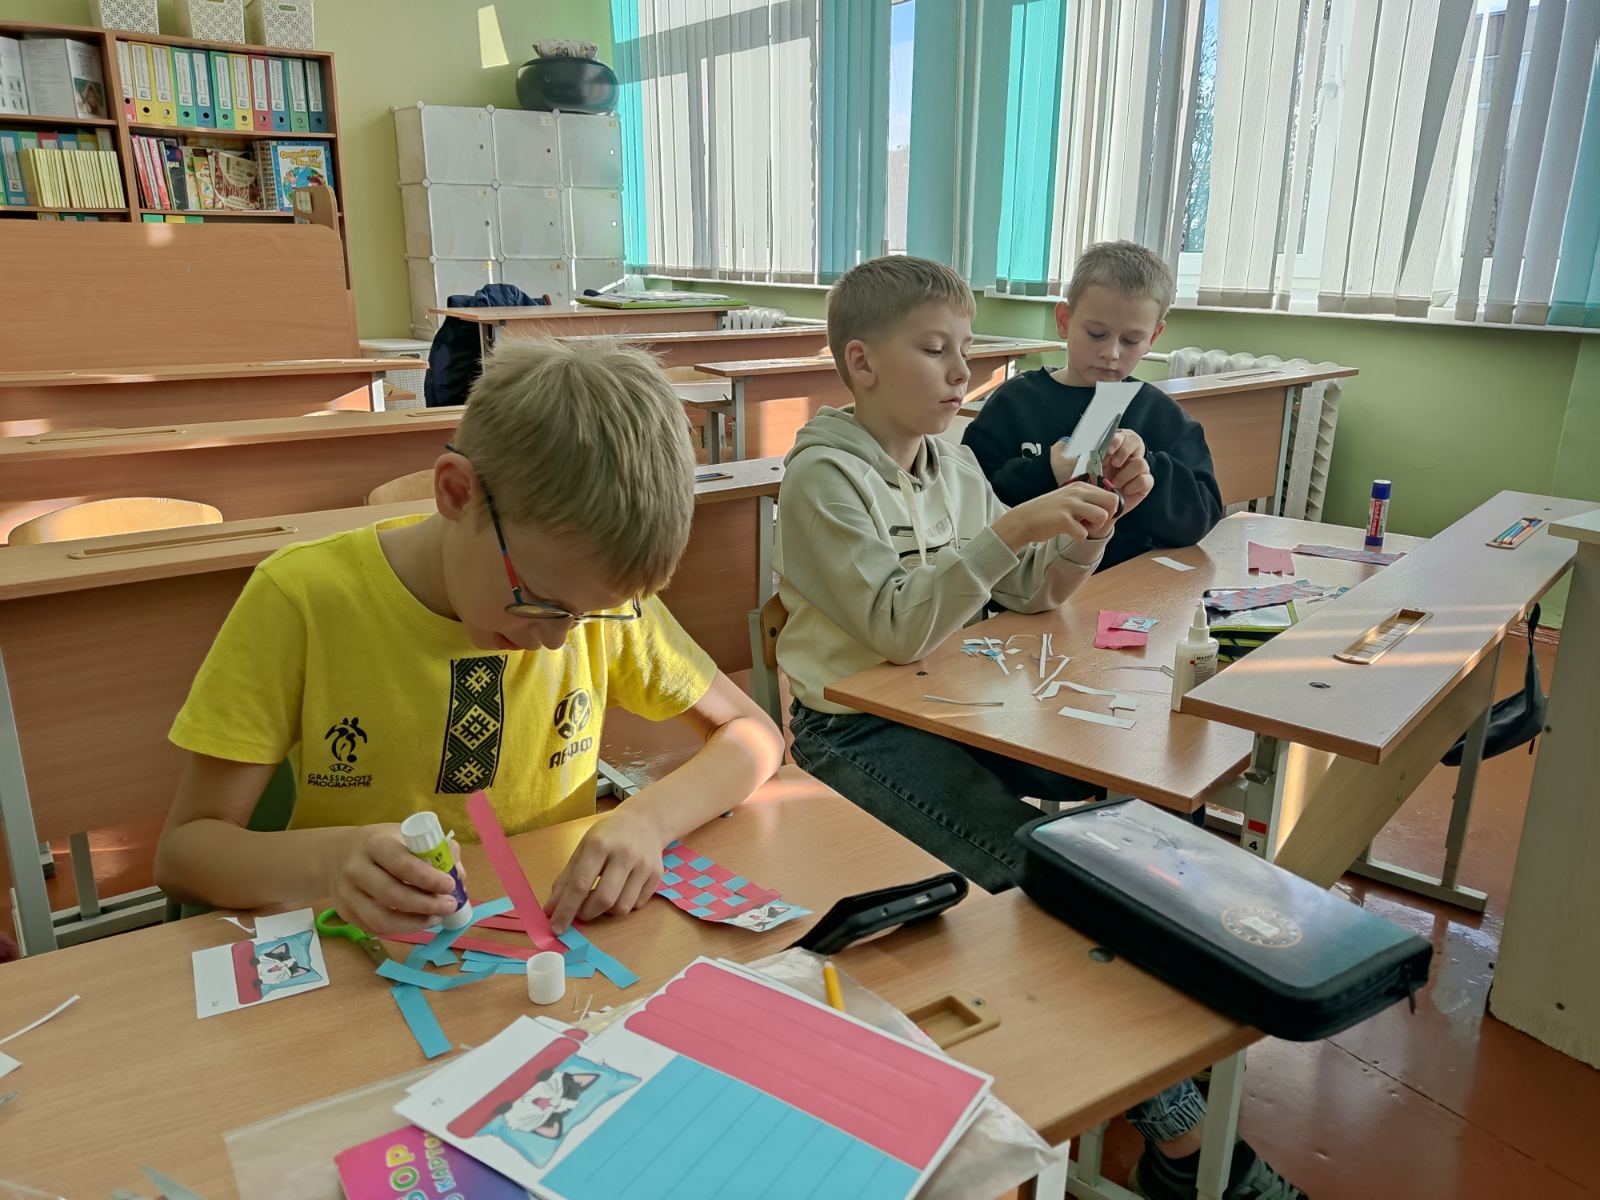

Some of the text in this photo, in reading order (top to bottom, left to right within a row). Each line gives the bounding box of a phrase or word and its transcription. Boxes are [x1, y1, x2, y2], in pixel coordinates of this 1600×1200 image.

[329, 763, 354, 773] UEFA
[308, 773, 373, 782] GRASSROOTS
[307, 779, 371, 788] PROGRAMME
[1248, 840, 1258, 851] 4
[424, 1134, 457, 1194] КАРТО
